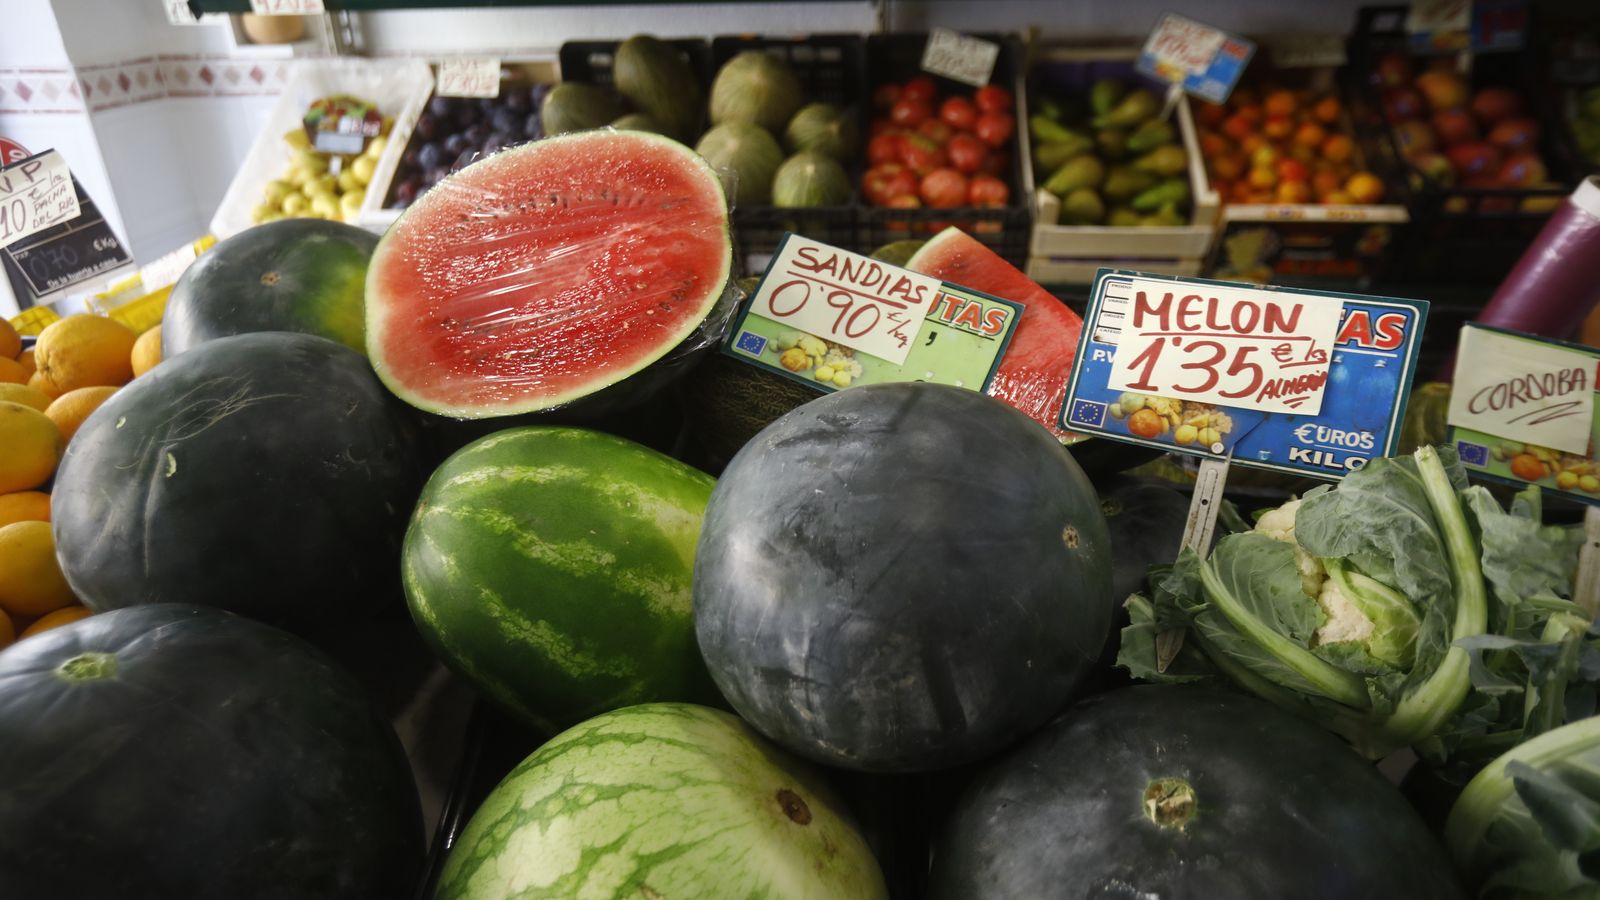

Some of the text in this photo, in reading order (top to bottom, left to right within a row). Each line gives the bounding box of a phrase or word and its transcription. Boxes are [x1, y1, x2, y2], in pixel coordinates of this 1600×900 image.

[791, 246, 928, 305] SANDIAS
[1132, 291, 1304, 334] MELON
[1336, 309, 1408, 351] AS
[1468, 367, 1587, 414] CORDOBA
